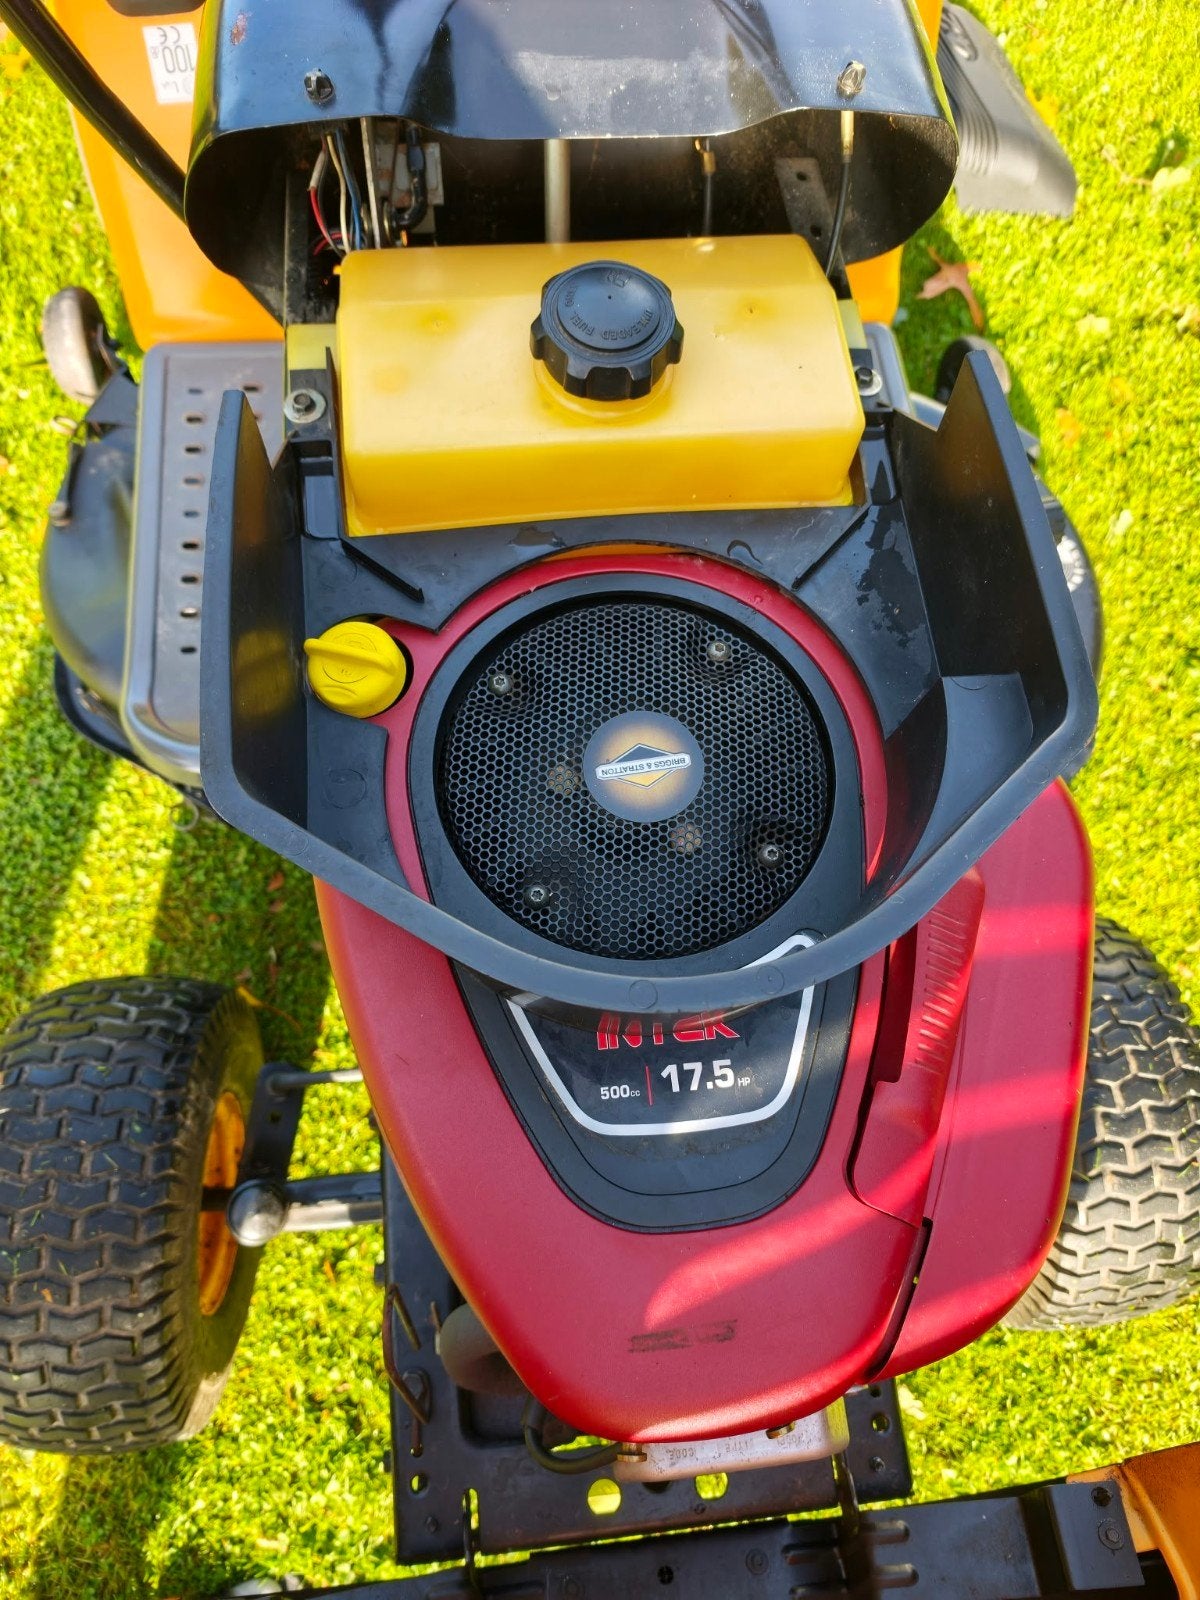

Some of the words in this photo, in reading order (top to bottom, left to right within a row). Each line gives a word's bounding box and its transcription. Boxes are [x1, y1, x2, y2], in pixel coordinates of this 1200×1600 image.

[162, 44, 195, 74] 100
[569, 311, 595, 336] FUEL
[601, 763, 645, 776] STRATTON
[654, 757, 686, 769] BRIGGS
[660, 1058, 735, 1093] 17.5
[737, 1077, 751, 1087] HP
